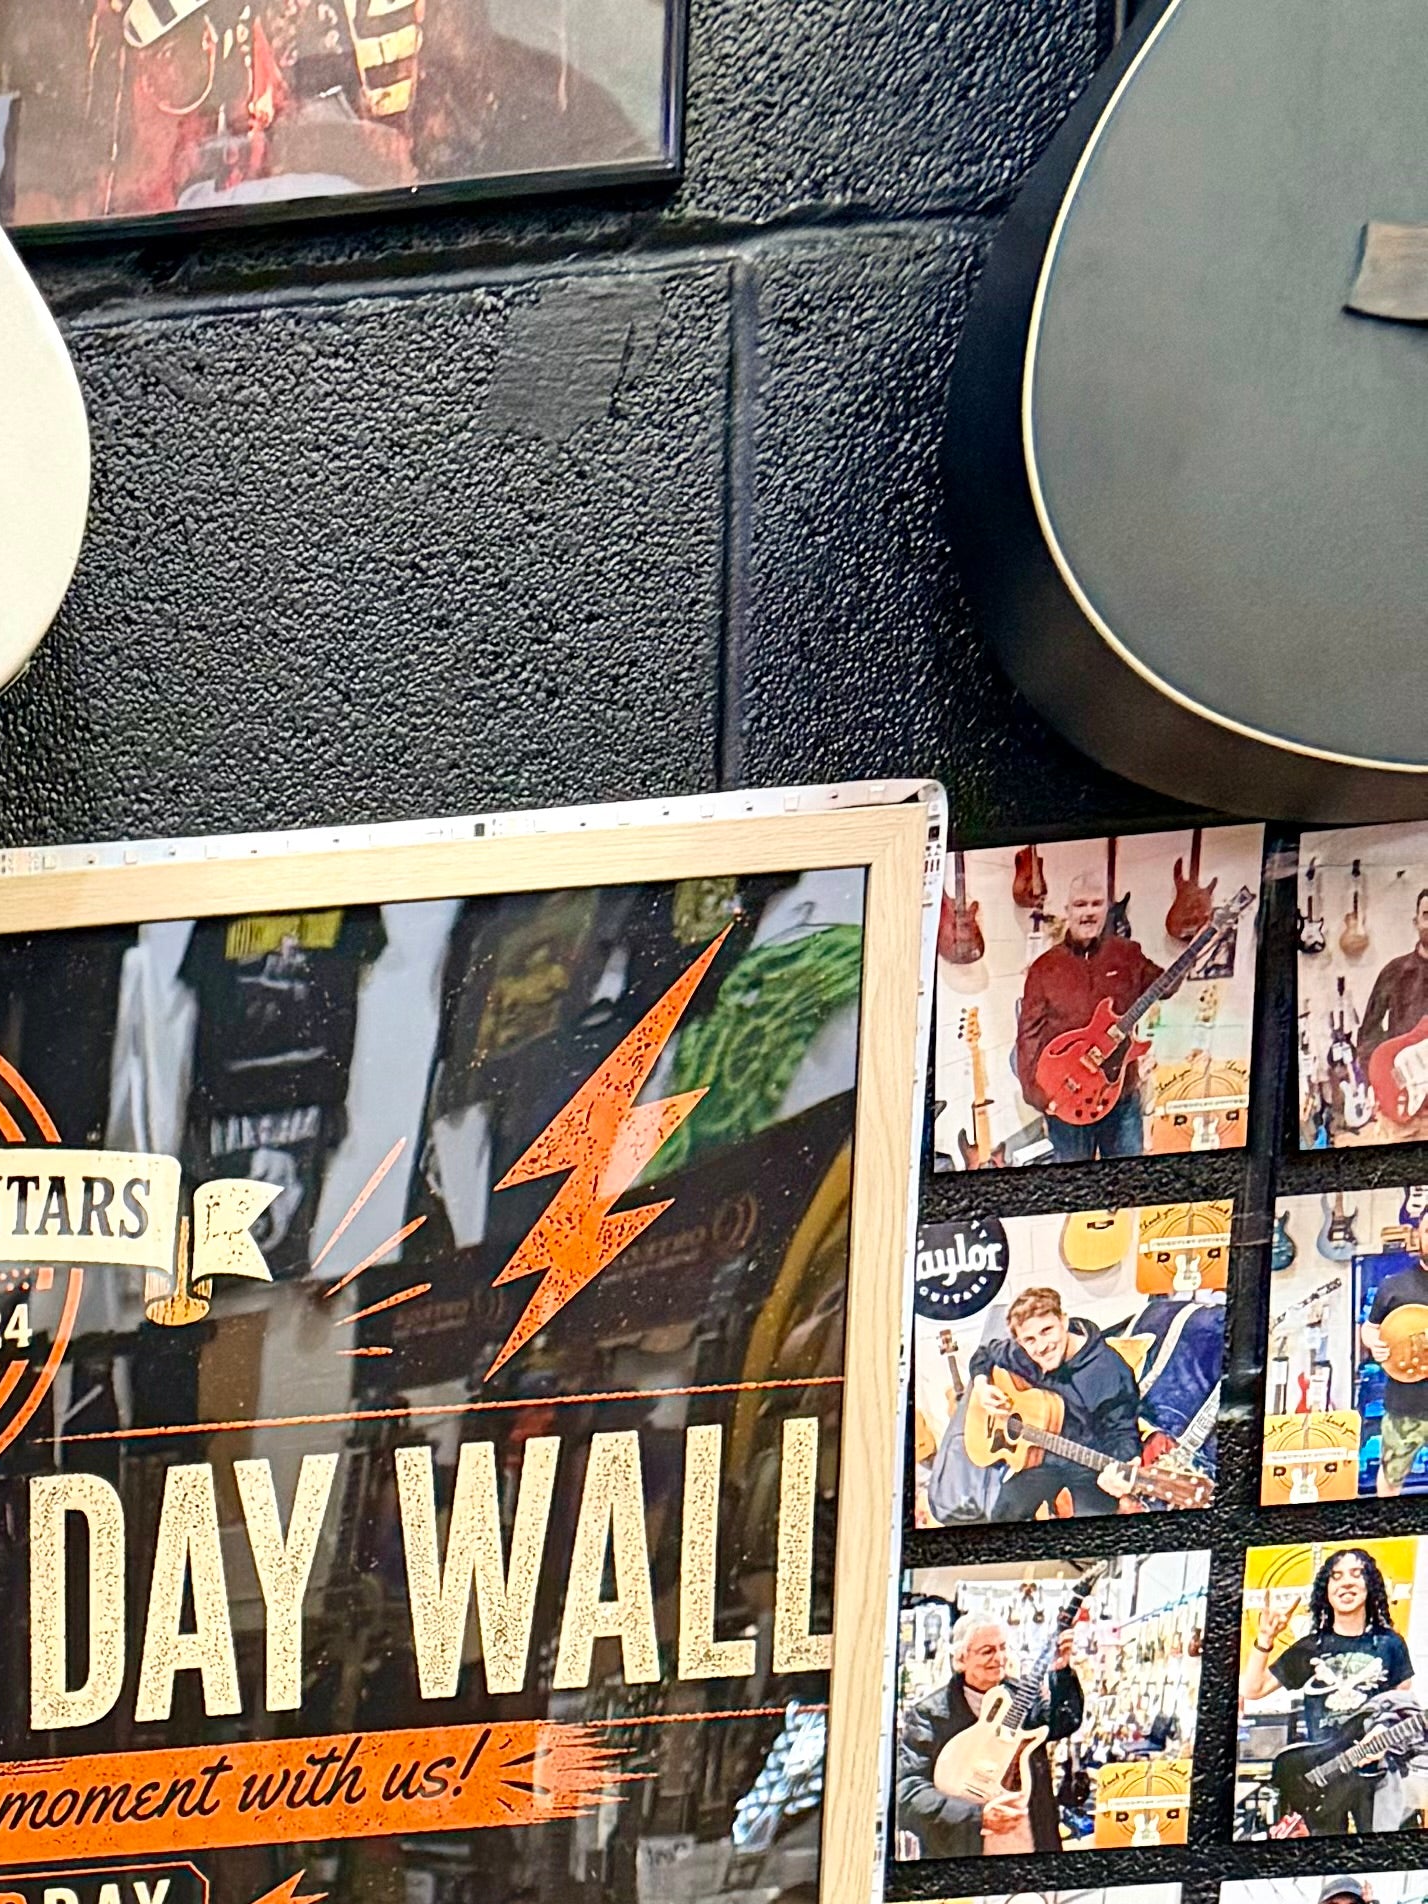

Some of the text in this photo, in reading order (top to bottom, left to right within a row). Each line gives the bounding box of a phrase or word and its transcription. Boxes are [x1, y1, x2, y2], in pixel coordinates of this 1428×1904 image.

[916, 1232, 1004, 1287] aylor
[29, 1452, 341, 1731] DAY
[394, 1416, 834, 1699] WALL
[238, 1736, 364, 1813] with
[381, 1728, 490, 1802] us!
